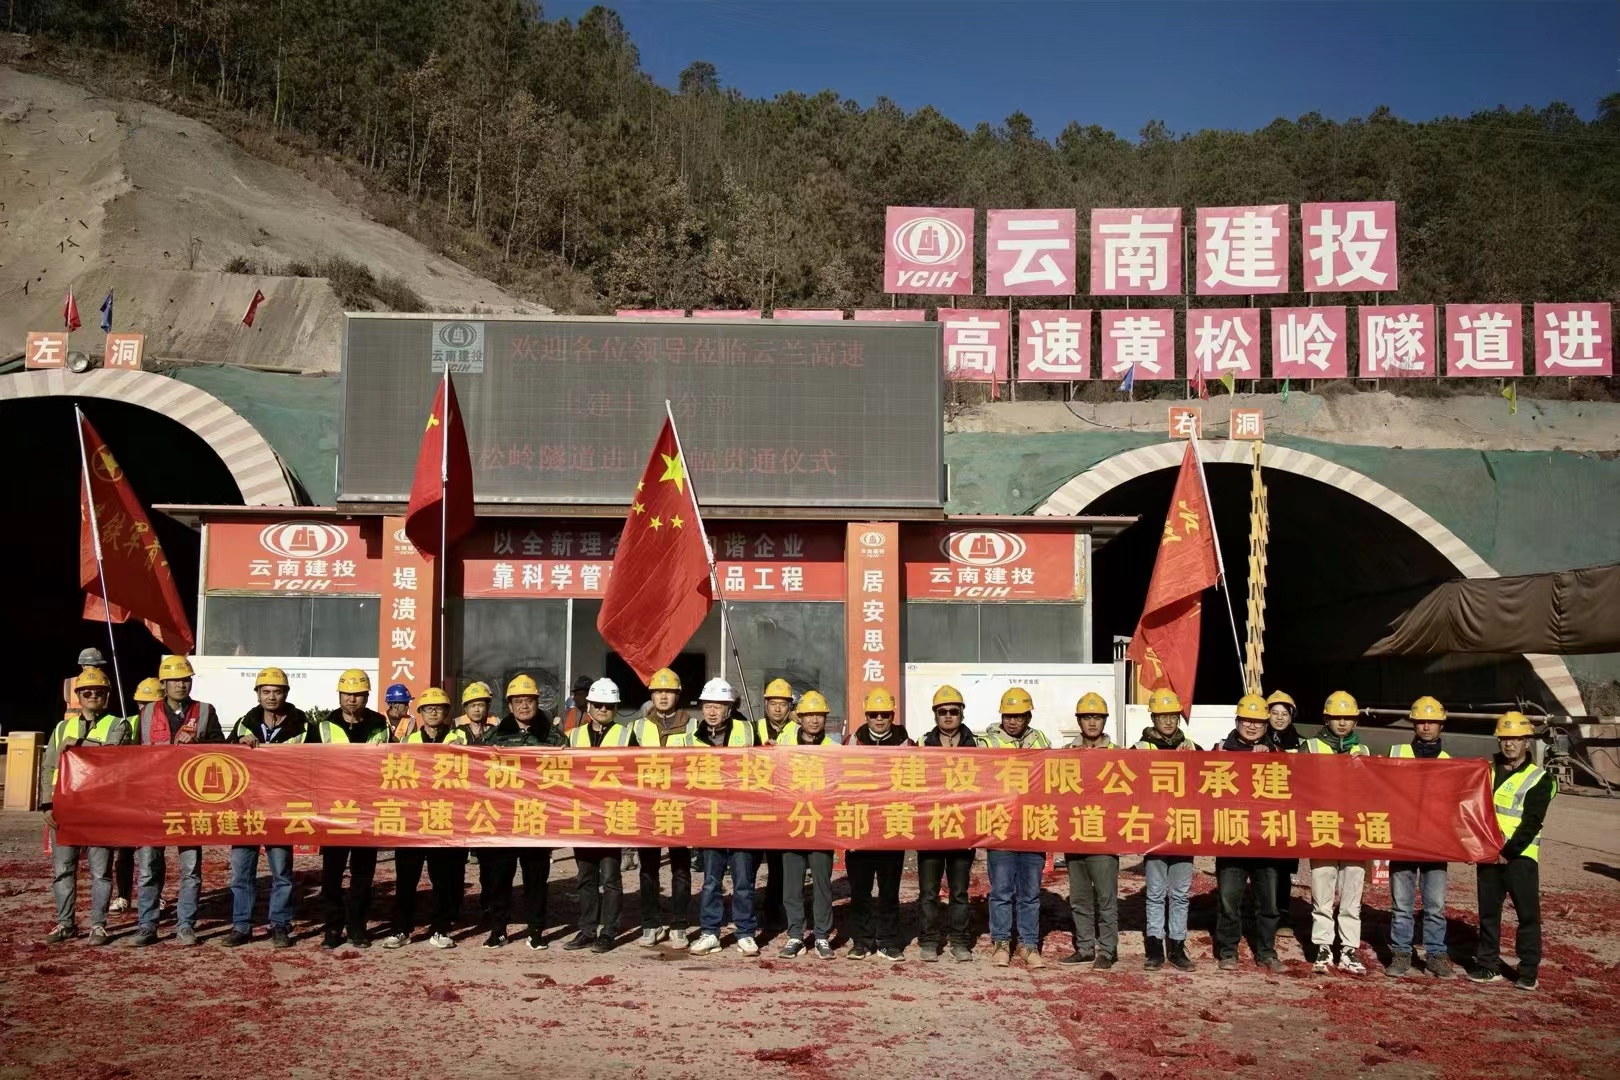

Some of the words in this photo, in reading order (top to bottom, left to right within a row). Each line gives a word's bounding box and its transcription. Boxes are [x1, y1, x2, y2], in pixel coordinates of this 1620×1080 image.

[998, 209, 1388, 289] 云南建投
[896, 271, 958, 287] YCIH
[33, 337, 139, 365] 左洞
[432, 350, 482, 362] 云南建投
[946, 311, 1603, 374] 高速黄松岭隧道进
[249, 559, 356, 577] 云南建投
[929, 566, 1035, 584] 云南建投
[273, 579, 332, 590] YCIH
[953, 586, 1012, 597] YCIH
[391, 566, 417, 681] 堤溃蚁穴
[863, 570, 885, 682] 居安思危
[380, 752, 1293, 799] 热烈祝贺云南建投第三建设有限公司承建
[162, 809, 268, 836] 云南建投
[281, 798, 1393, 849] 云兰高速公路土建第十一分部黄松岭隧道右洞顺利贯通
